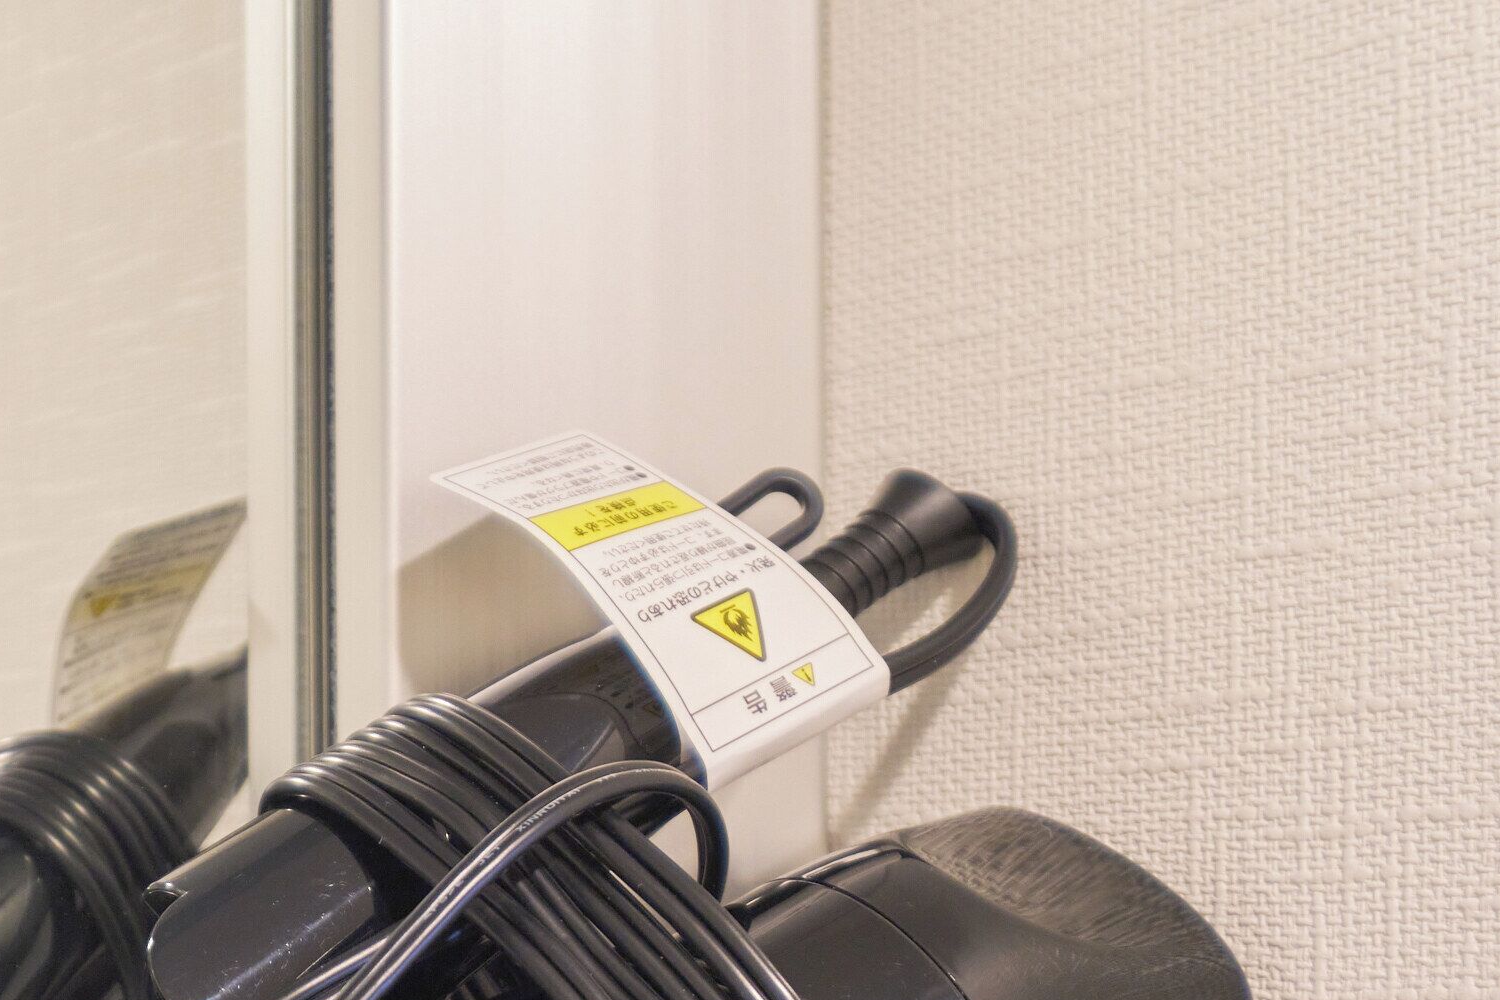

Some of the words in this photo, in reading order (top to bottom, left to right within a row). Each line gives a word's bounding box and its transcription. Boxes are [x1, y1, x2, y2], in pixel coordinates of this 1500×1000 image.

[573, 500, 679, 537] ご使用の前に必ず
[637, 554, 776, 623] 発火・やけどの恐れあり
